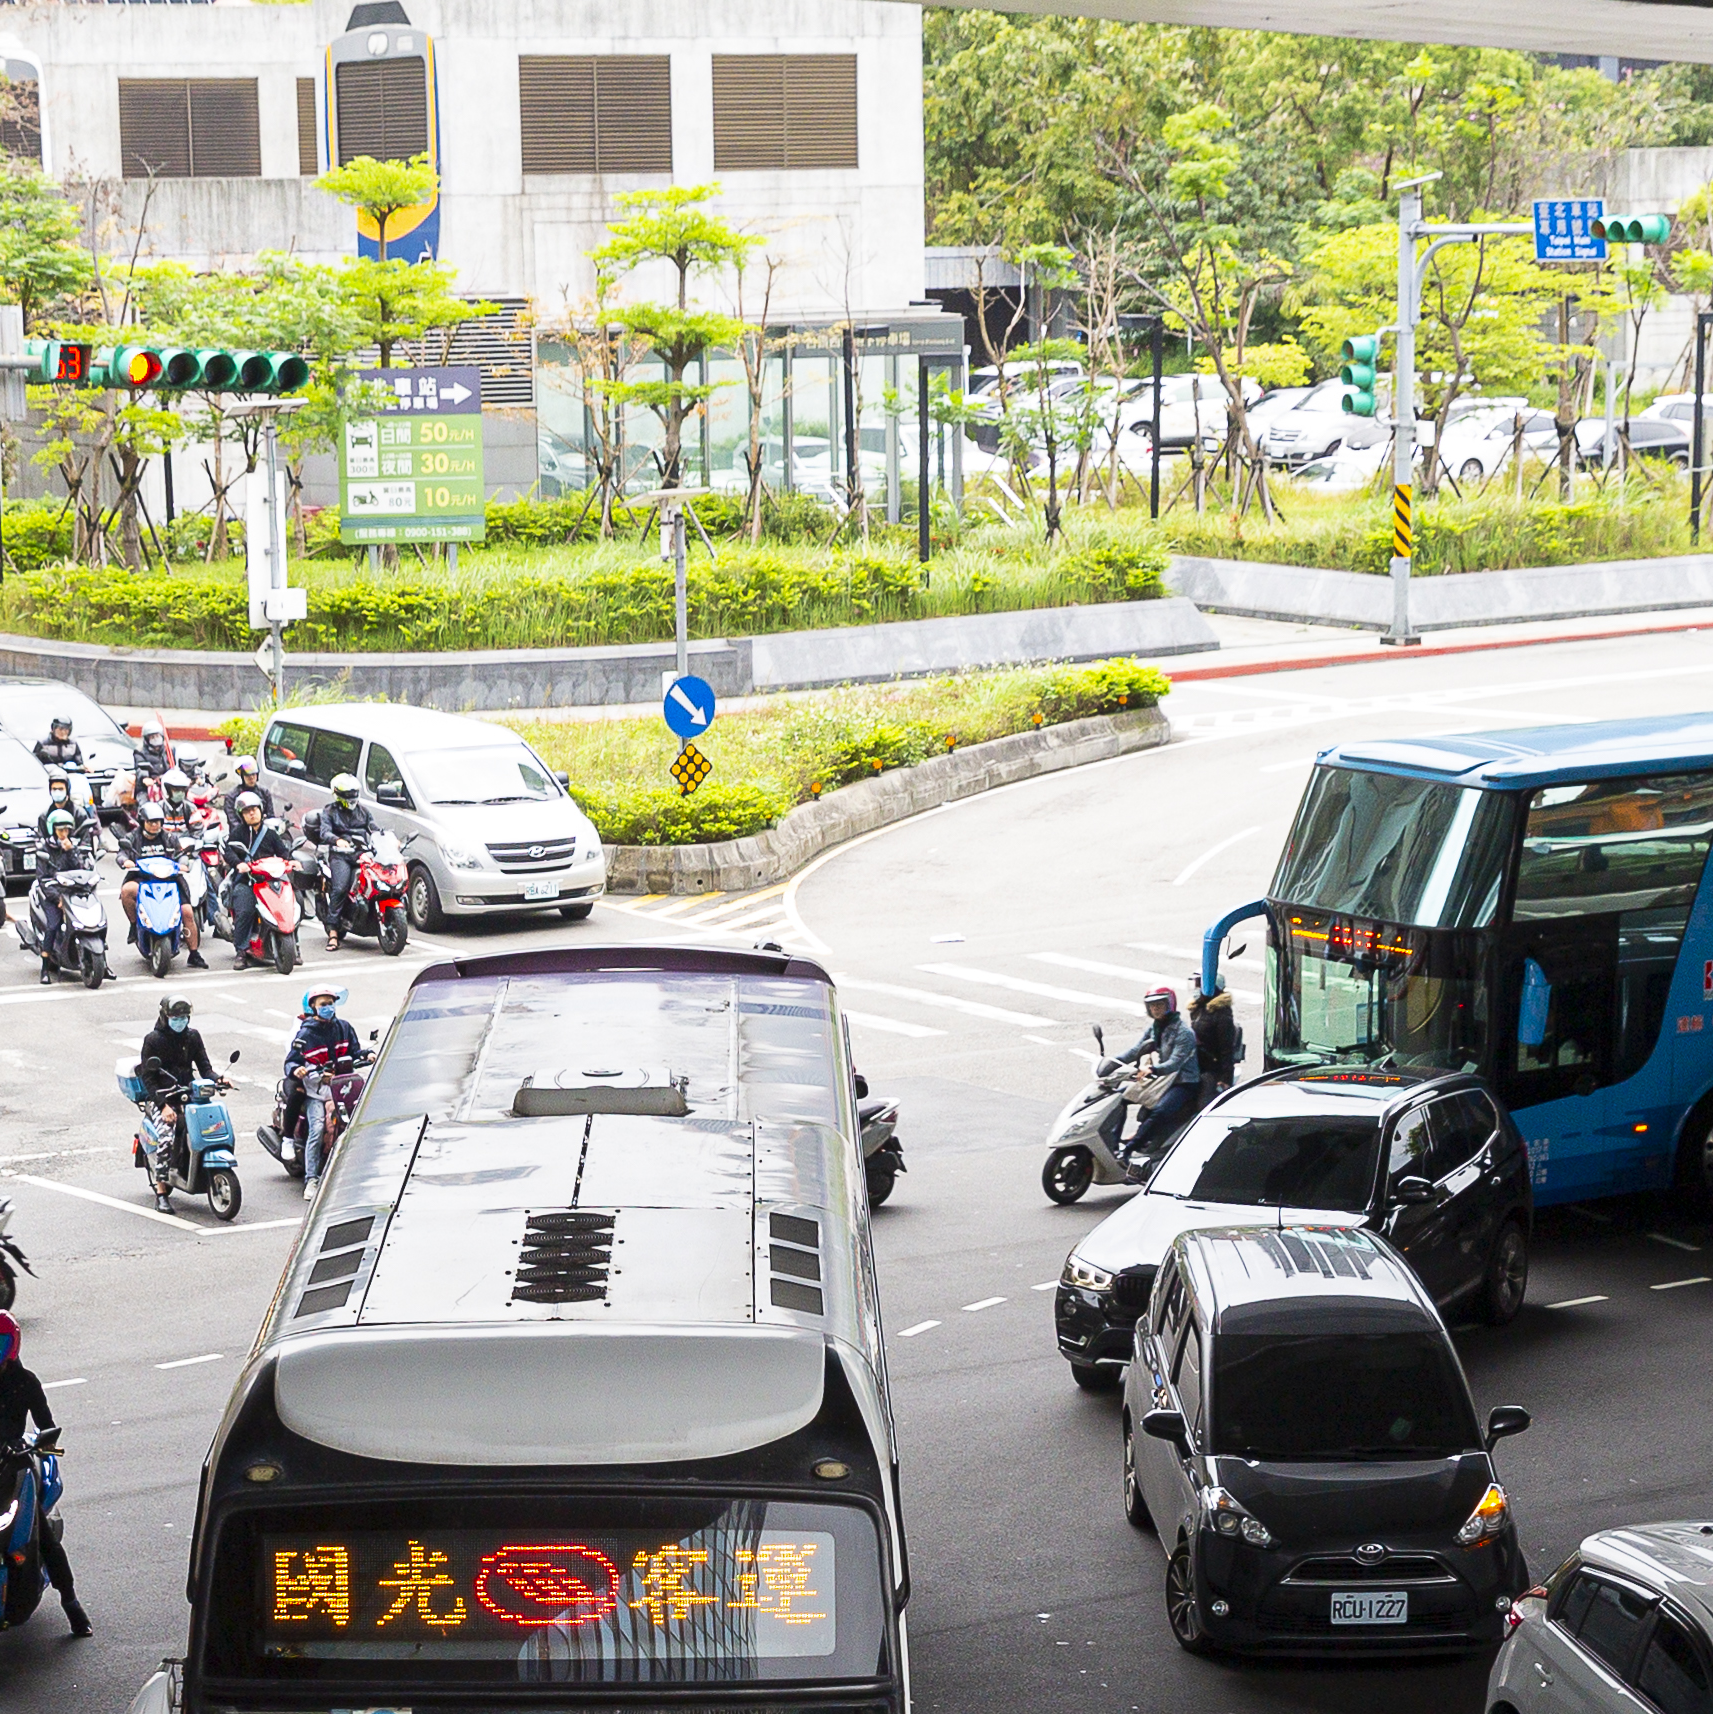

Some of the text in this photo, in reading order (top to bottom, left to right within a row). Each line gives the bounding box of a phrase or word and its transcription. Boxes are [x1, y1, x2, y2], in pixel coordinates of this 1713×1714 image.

[1540, 218, 1592, 235] 專用號
[1332, 1599, 1406, 1619] RCU-1227
